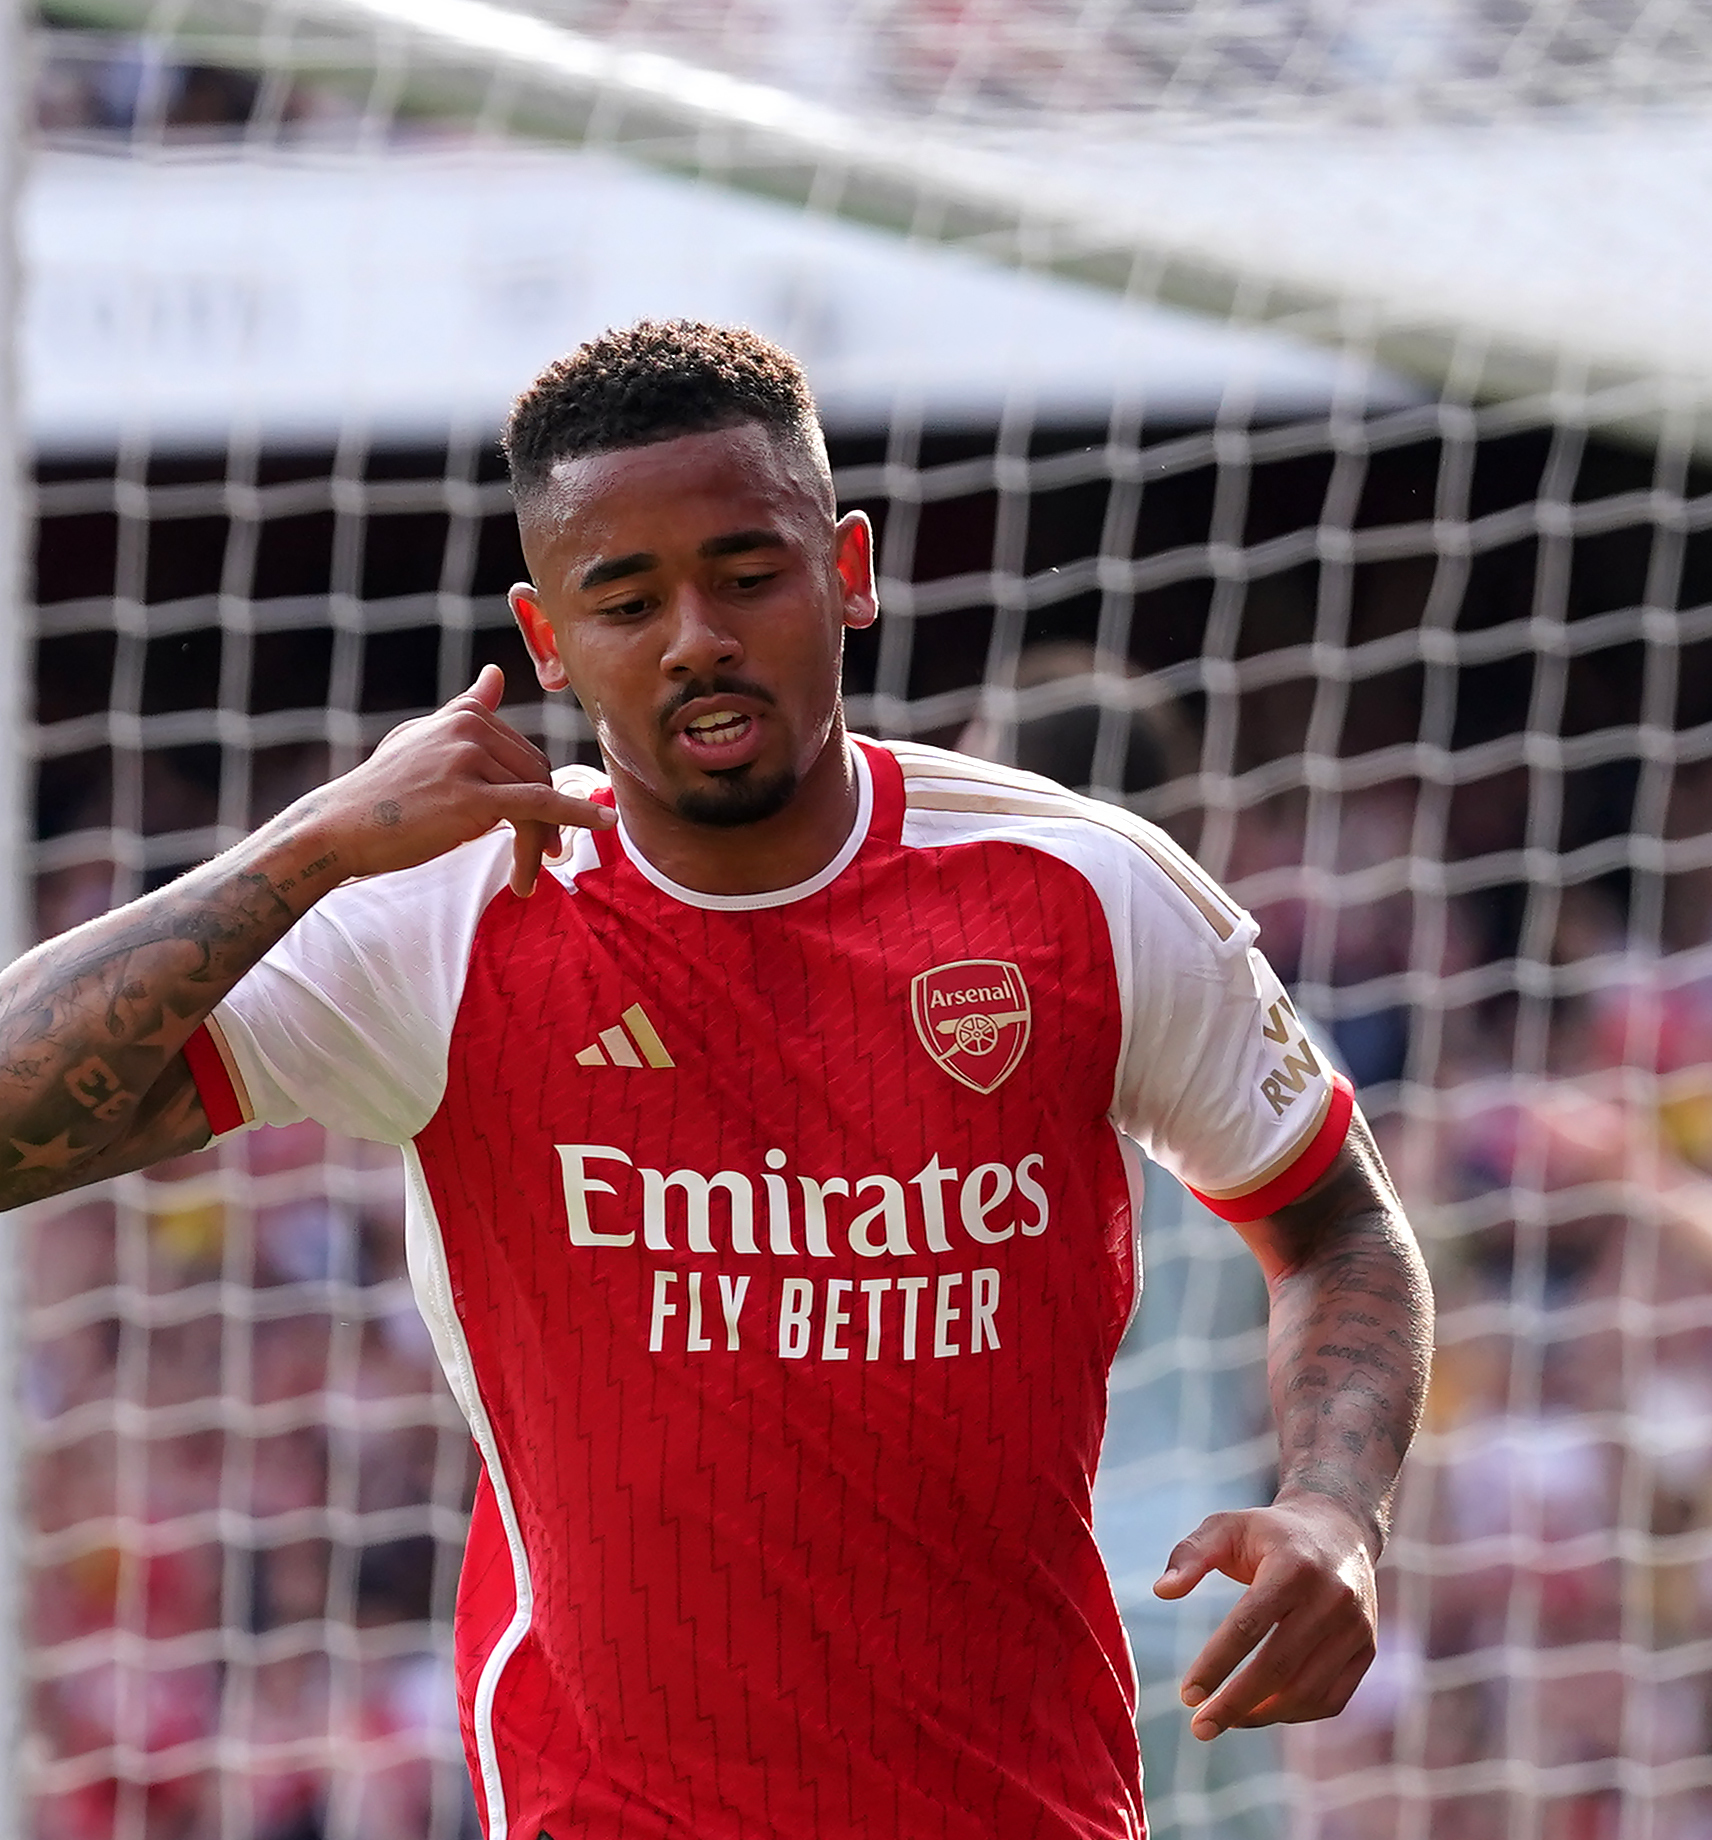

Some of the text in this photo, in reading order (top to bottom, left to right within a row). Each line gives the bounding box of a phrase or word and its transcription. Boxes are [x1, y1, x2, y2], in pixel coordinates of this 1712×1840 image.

[930, 980, 1012, 1008] Arsenal
[554, 1145, 1049, 1257] Emirates
[649, 1268, 1001, 1360] FLY BETTER
